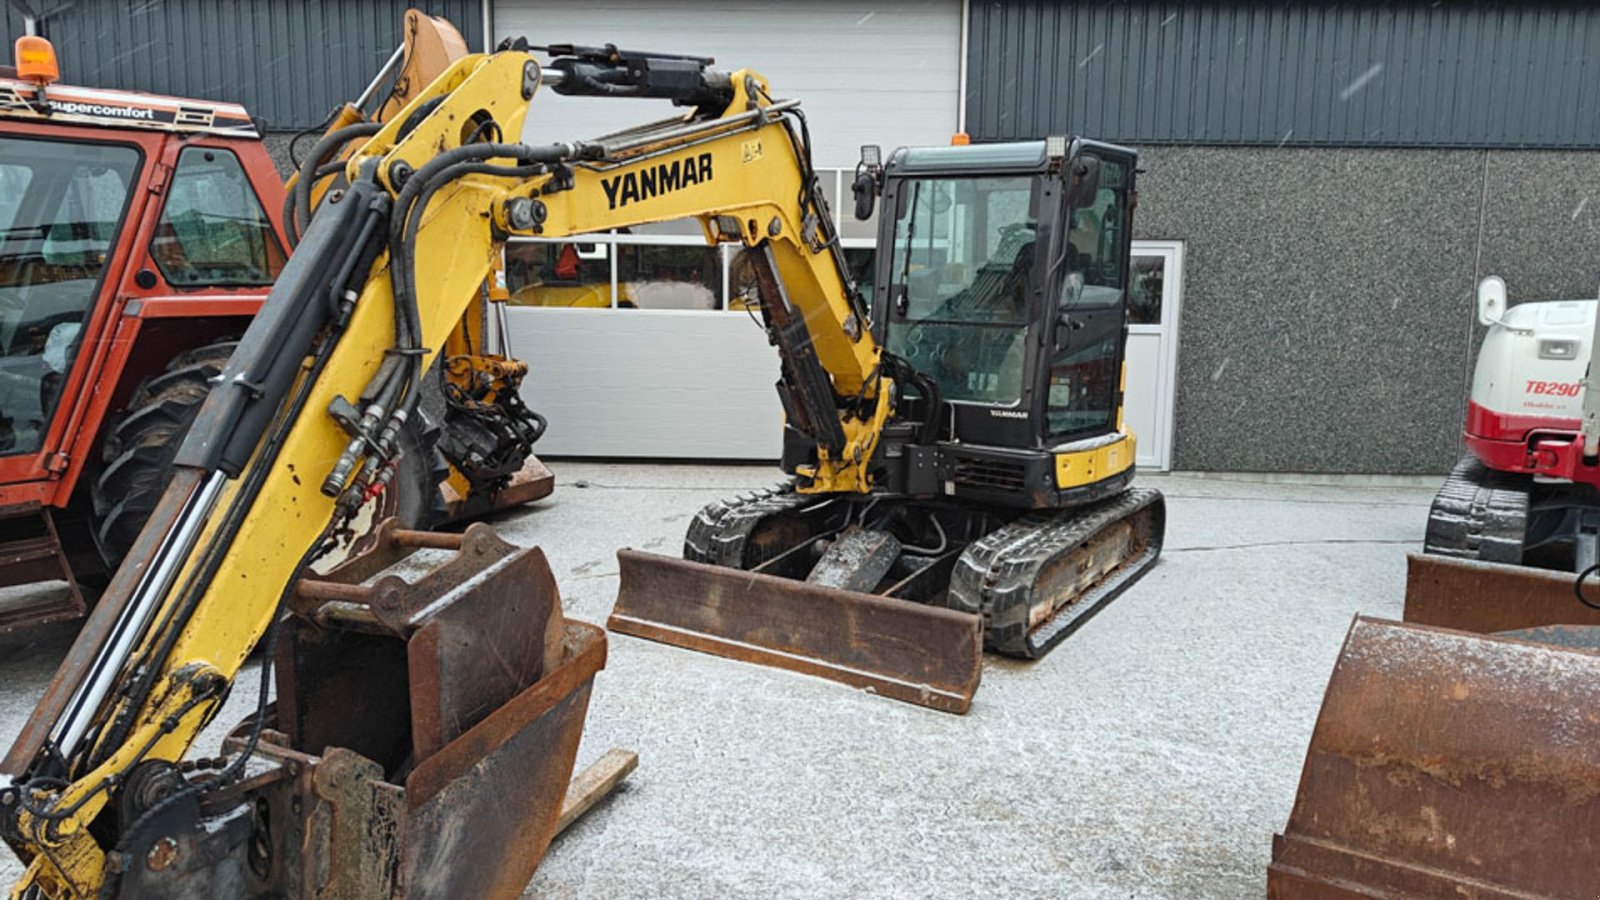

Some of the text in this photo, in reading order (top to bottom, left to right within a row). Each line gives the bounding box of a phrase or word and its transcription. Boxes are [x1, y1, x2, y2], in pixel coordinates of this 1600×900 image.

[48, 101, 154, 119] supercomfort
[601, 152, 713, 210] YANMAR
[1526, 380, 1581, 397] TB290
